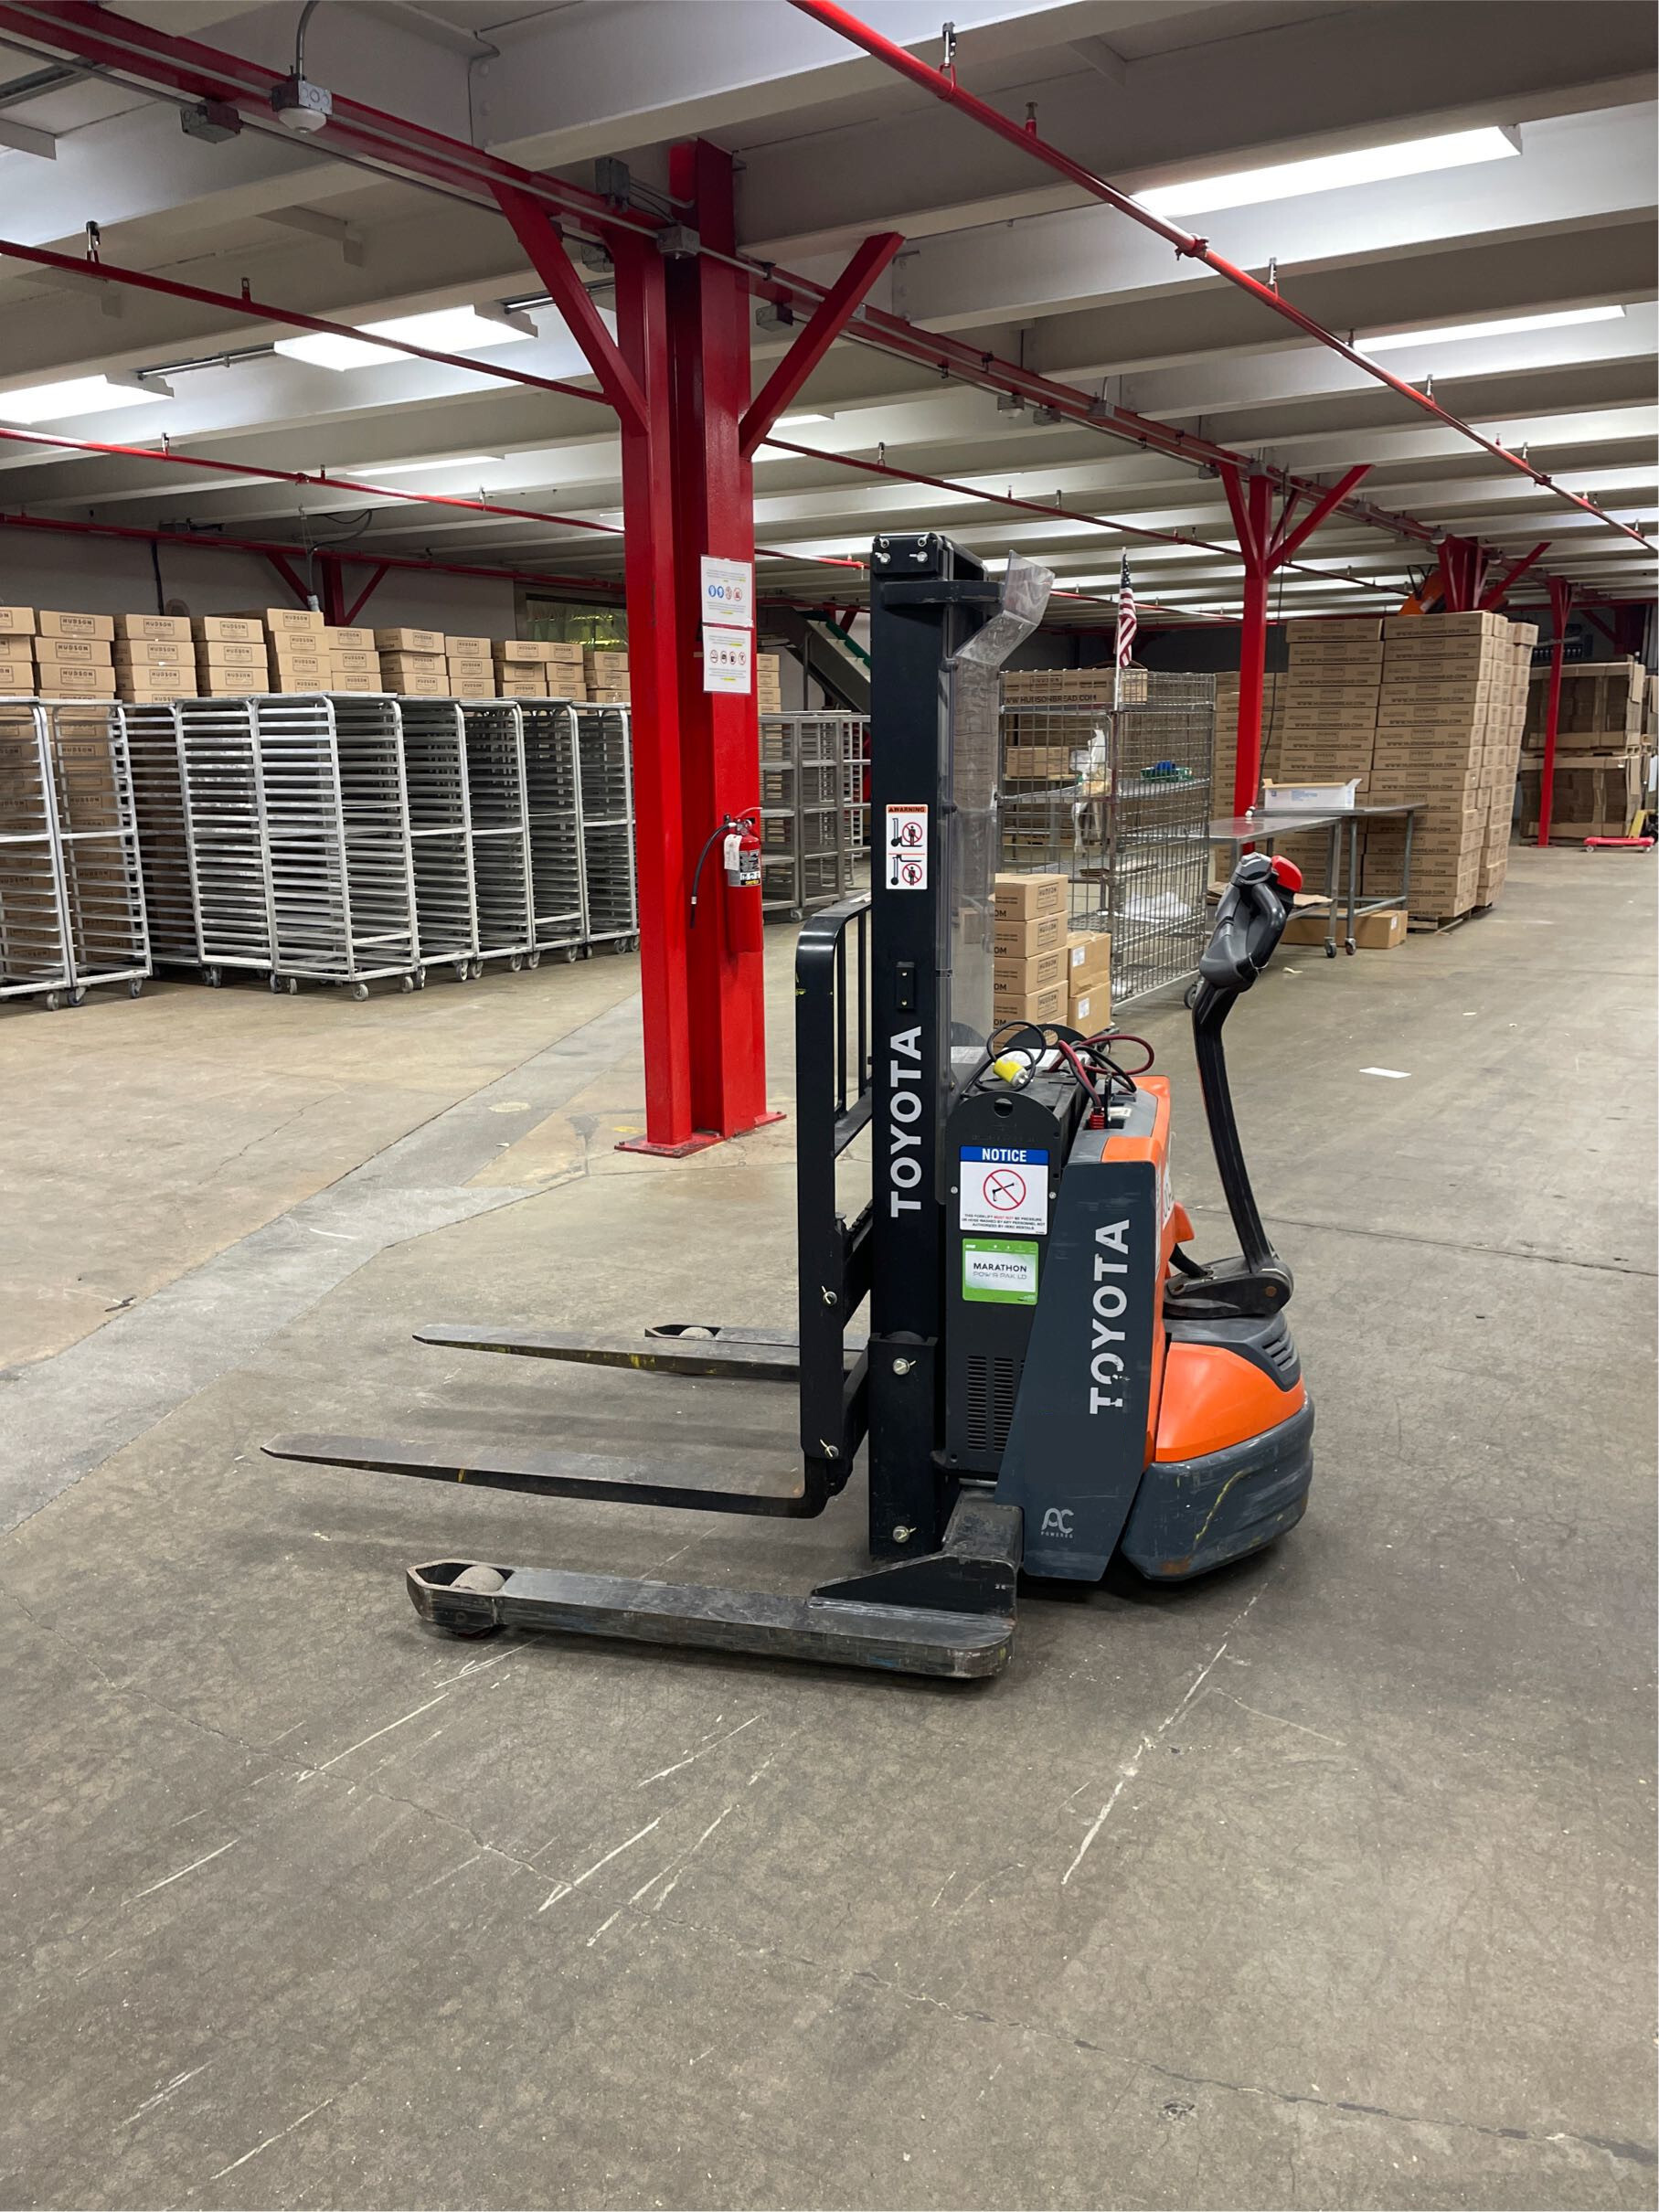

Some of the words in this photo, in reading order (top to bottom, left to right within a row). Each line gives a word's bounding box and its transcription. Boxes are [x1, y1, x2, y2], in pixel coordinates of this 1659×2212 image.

[889, 1026, 922, 1218] TOYOTA
[982, 1147, 1027, 1163] NOTICE
[973, 1262, 1027, 1272] MARATHON
[1090, 1218, 1131, 1415] TOYOTA
